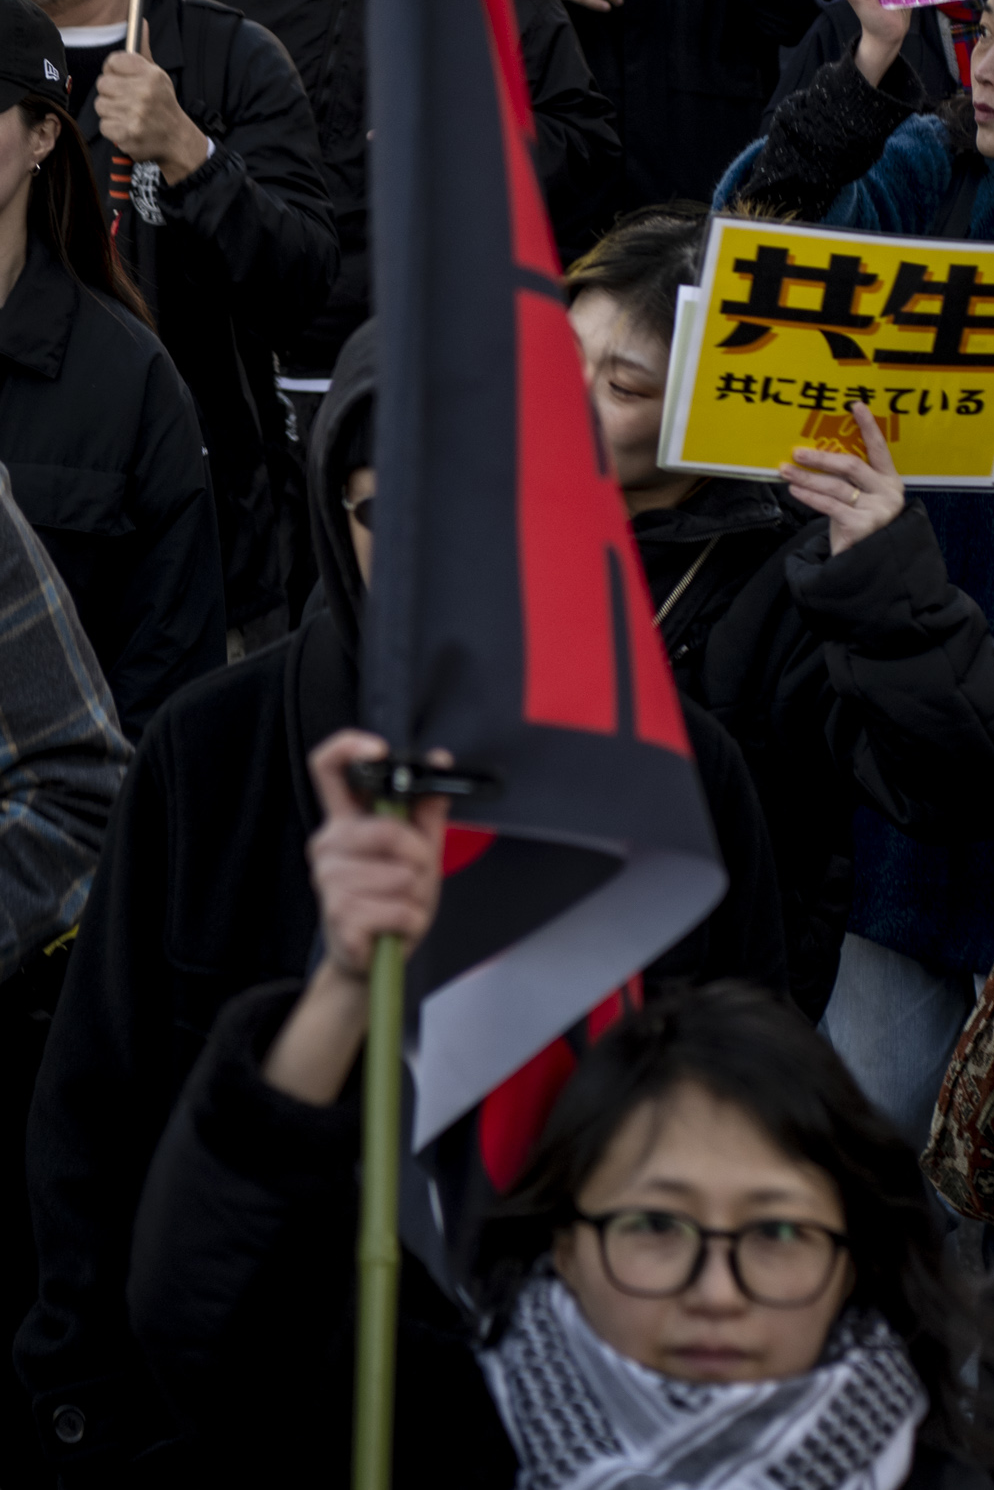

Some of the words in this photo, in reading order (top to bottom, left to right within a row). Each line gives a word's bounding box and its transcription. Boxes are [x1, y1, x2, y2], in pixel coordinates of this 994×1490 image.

[714, 371, 986, 417] 共に生きている
